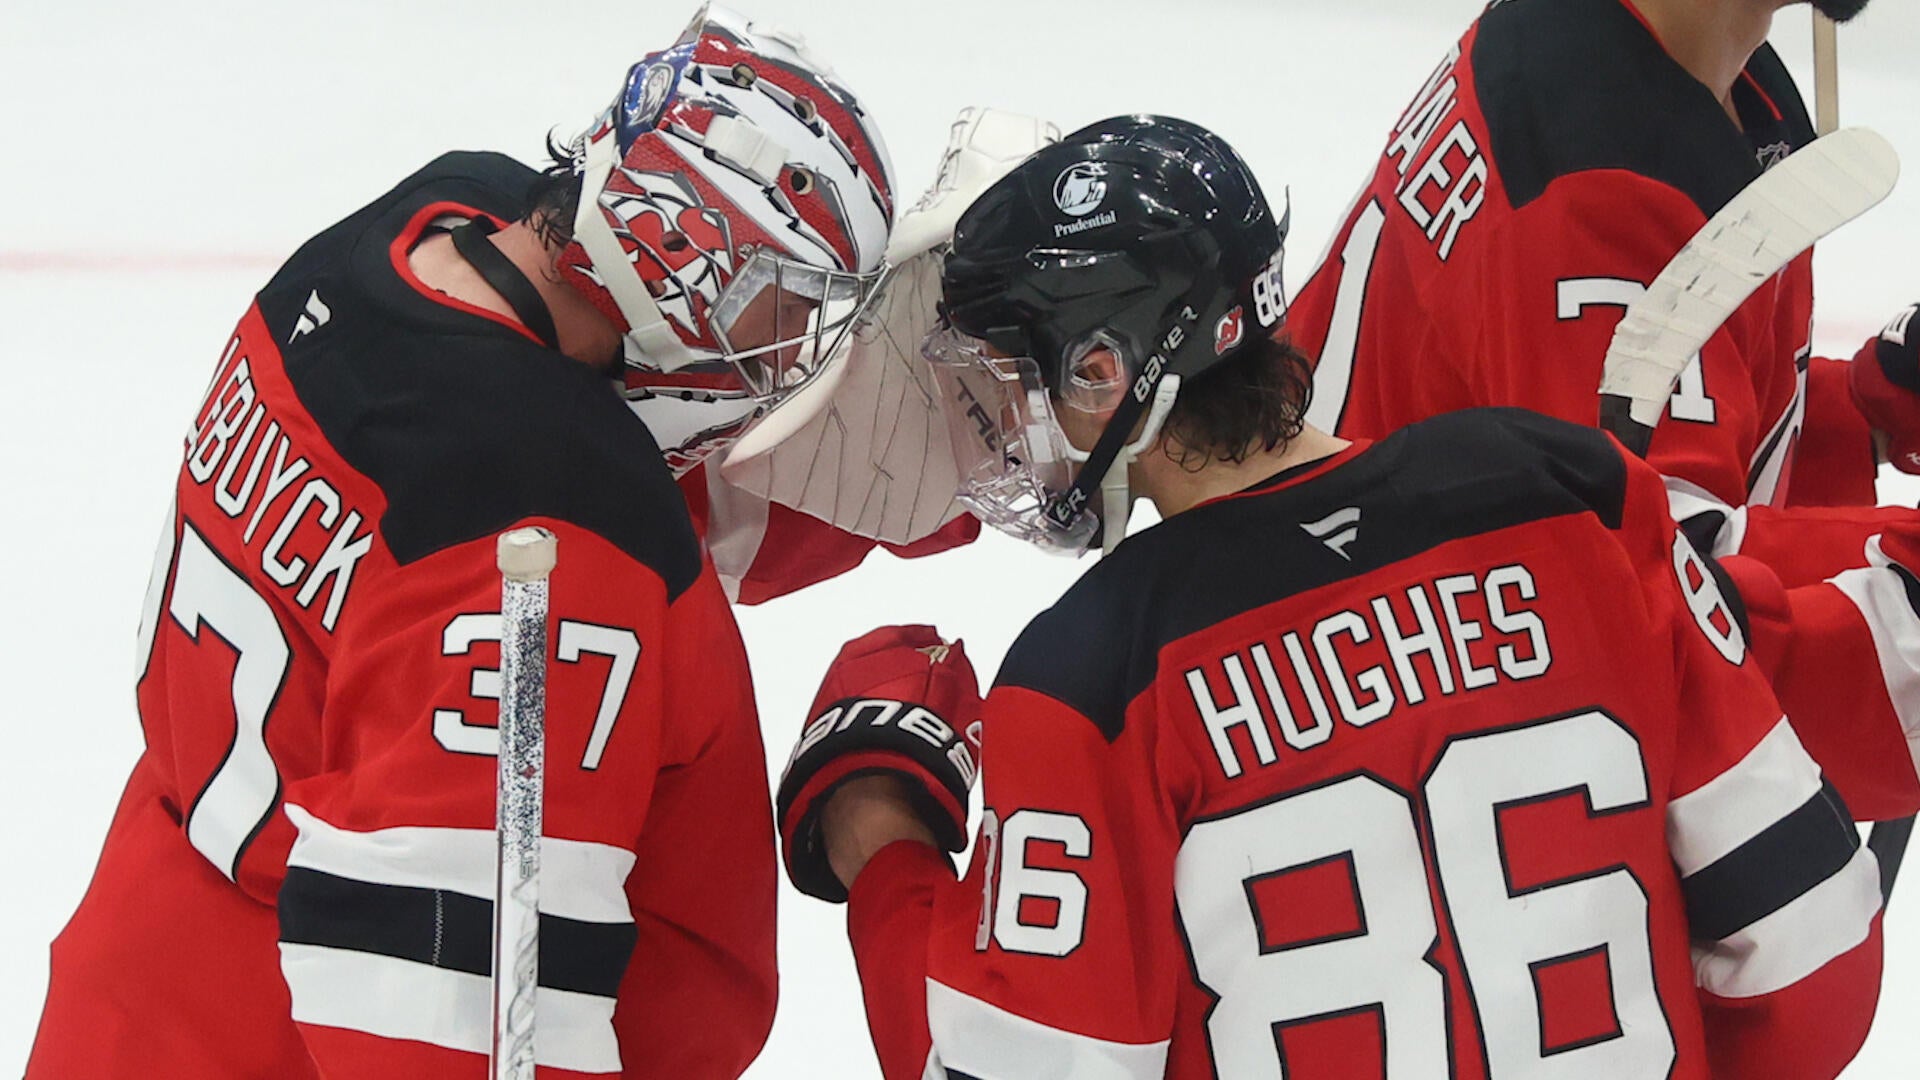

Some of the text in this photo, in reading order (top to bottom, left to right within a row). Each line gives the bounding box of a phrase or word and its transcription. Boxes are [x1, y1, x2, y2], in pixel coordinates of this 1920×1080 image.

[1054, 209, 1117, 238] Prudential
[1252, 254, 1287, 327] 86
[432, 611, 642, 771] 37
[1184, 563, 1553, 779] HUGHES
[1173, 707, 1678, 1080] 86
